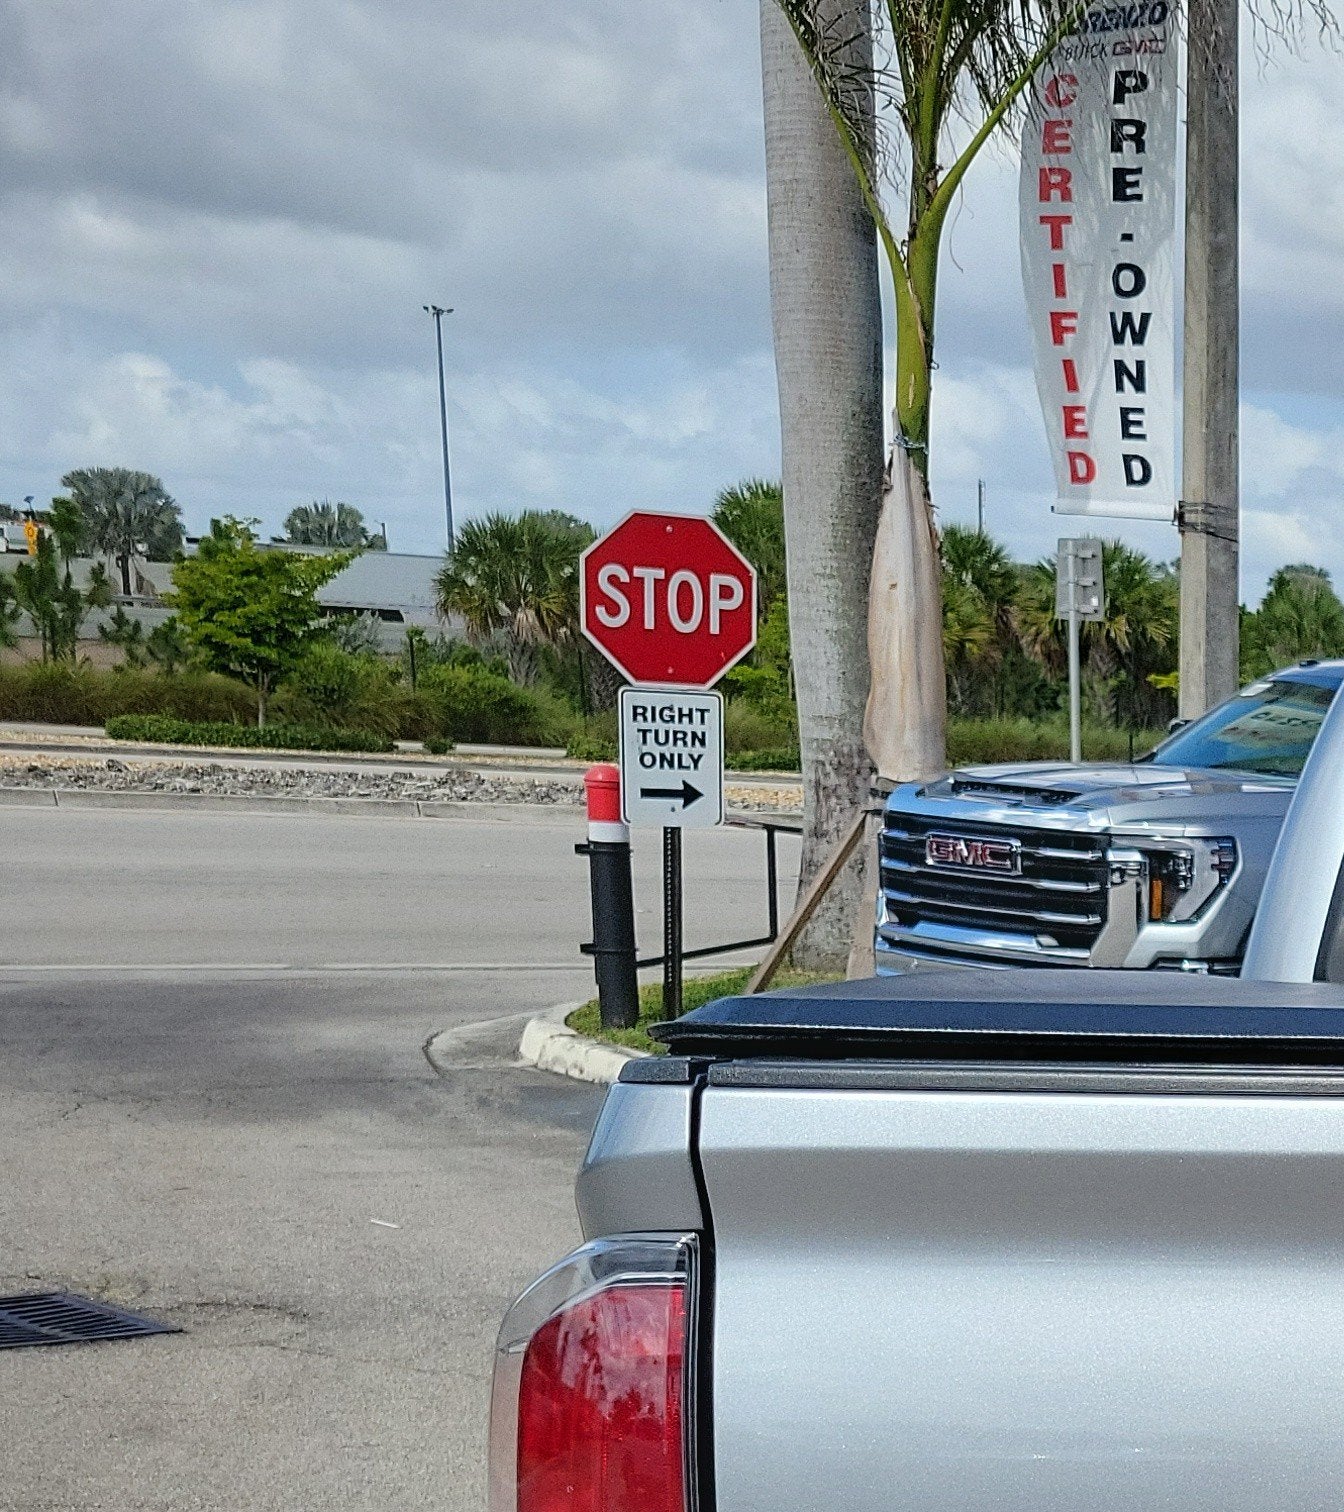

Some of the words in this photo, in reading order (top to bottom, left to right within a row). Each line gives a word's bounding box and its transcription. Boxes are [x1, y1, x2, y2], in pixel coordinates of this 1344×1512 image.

[1038, 73, 1097, 487] CERTIFIED
[1108, 69, 1153, 488] PRE-OWNED
[595, 562, 744, 636] STOP
[631, 704, 710, 726] RIGHT
[636, 728, 707, 748] TURN
[638, 751, 704, 771] ONLY
[929, 836, 1014, 869] GMC
